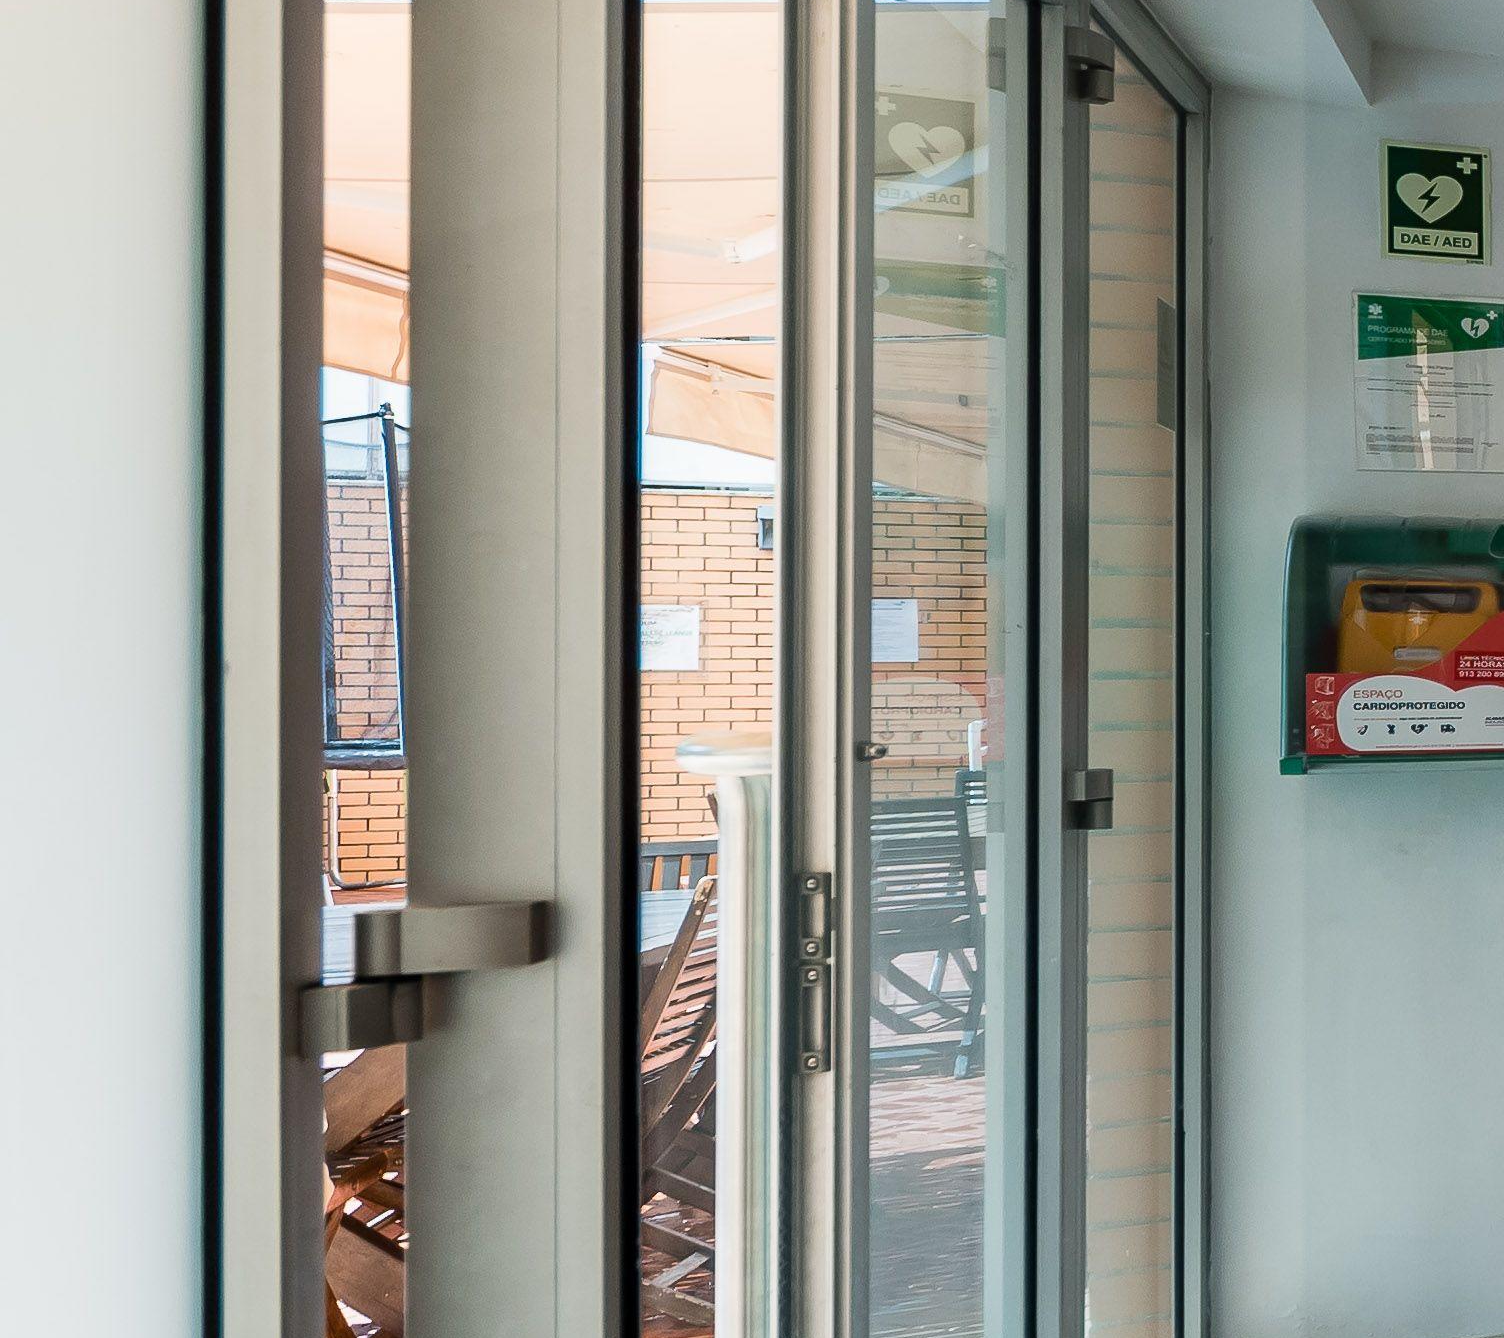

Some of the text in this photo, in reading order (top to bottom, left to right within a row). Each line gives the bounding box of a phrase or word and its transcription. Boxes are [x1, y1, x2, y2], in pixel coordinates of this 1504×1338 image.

[1400, 233, 1430, 246] DAE
[1441, 236, 1472, 248] AED
[1367, 325, 1416, 335] PROGRAMA
[1431, 328, 1448, 337] DAE
[1353, 689, 1403, 700] ESPAÇO
[1353, 701, 1466, 711] CARDIOPROTEGIDO
